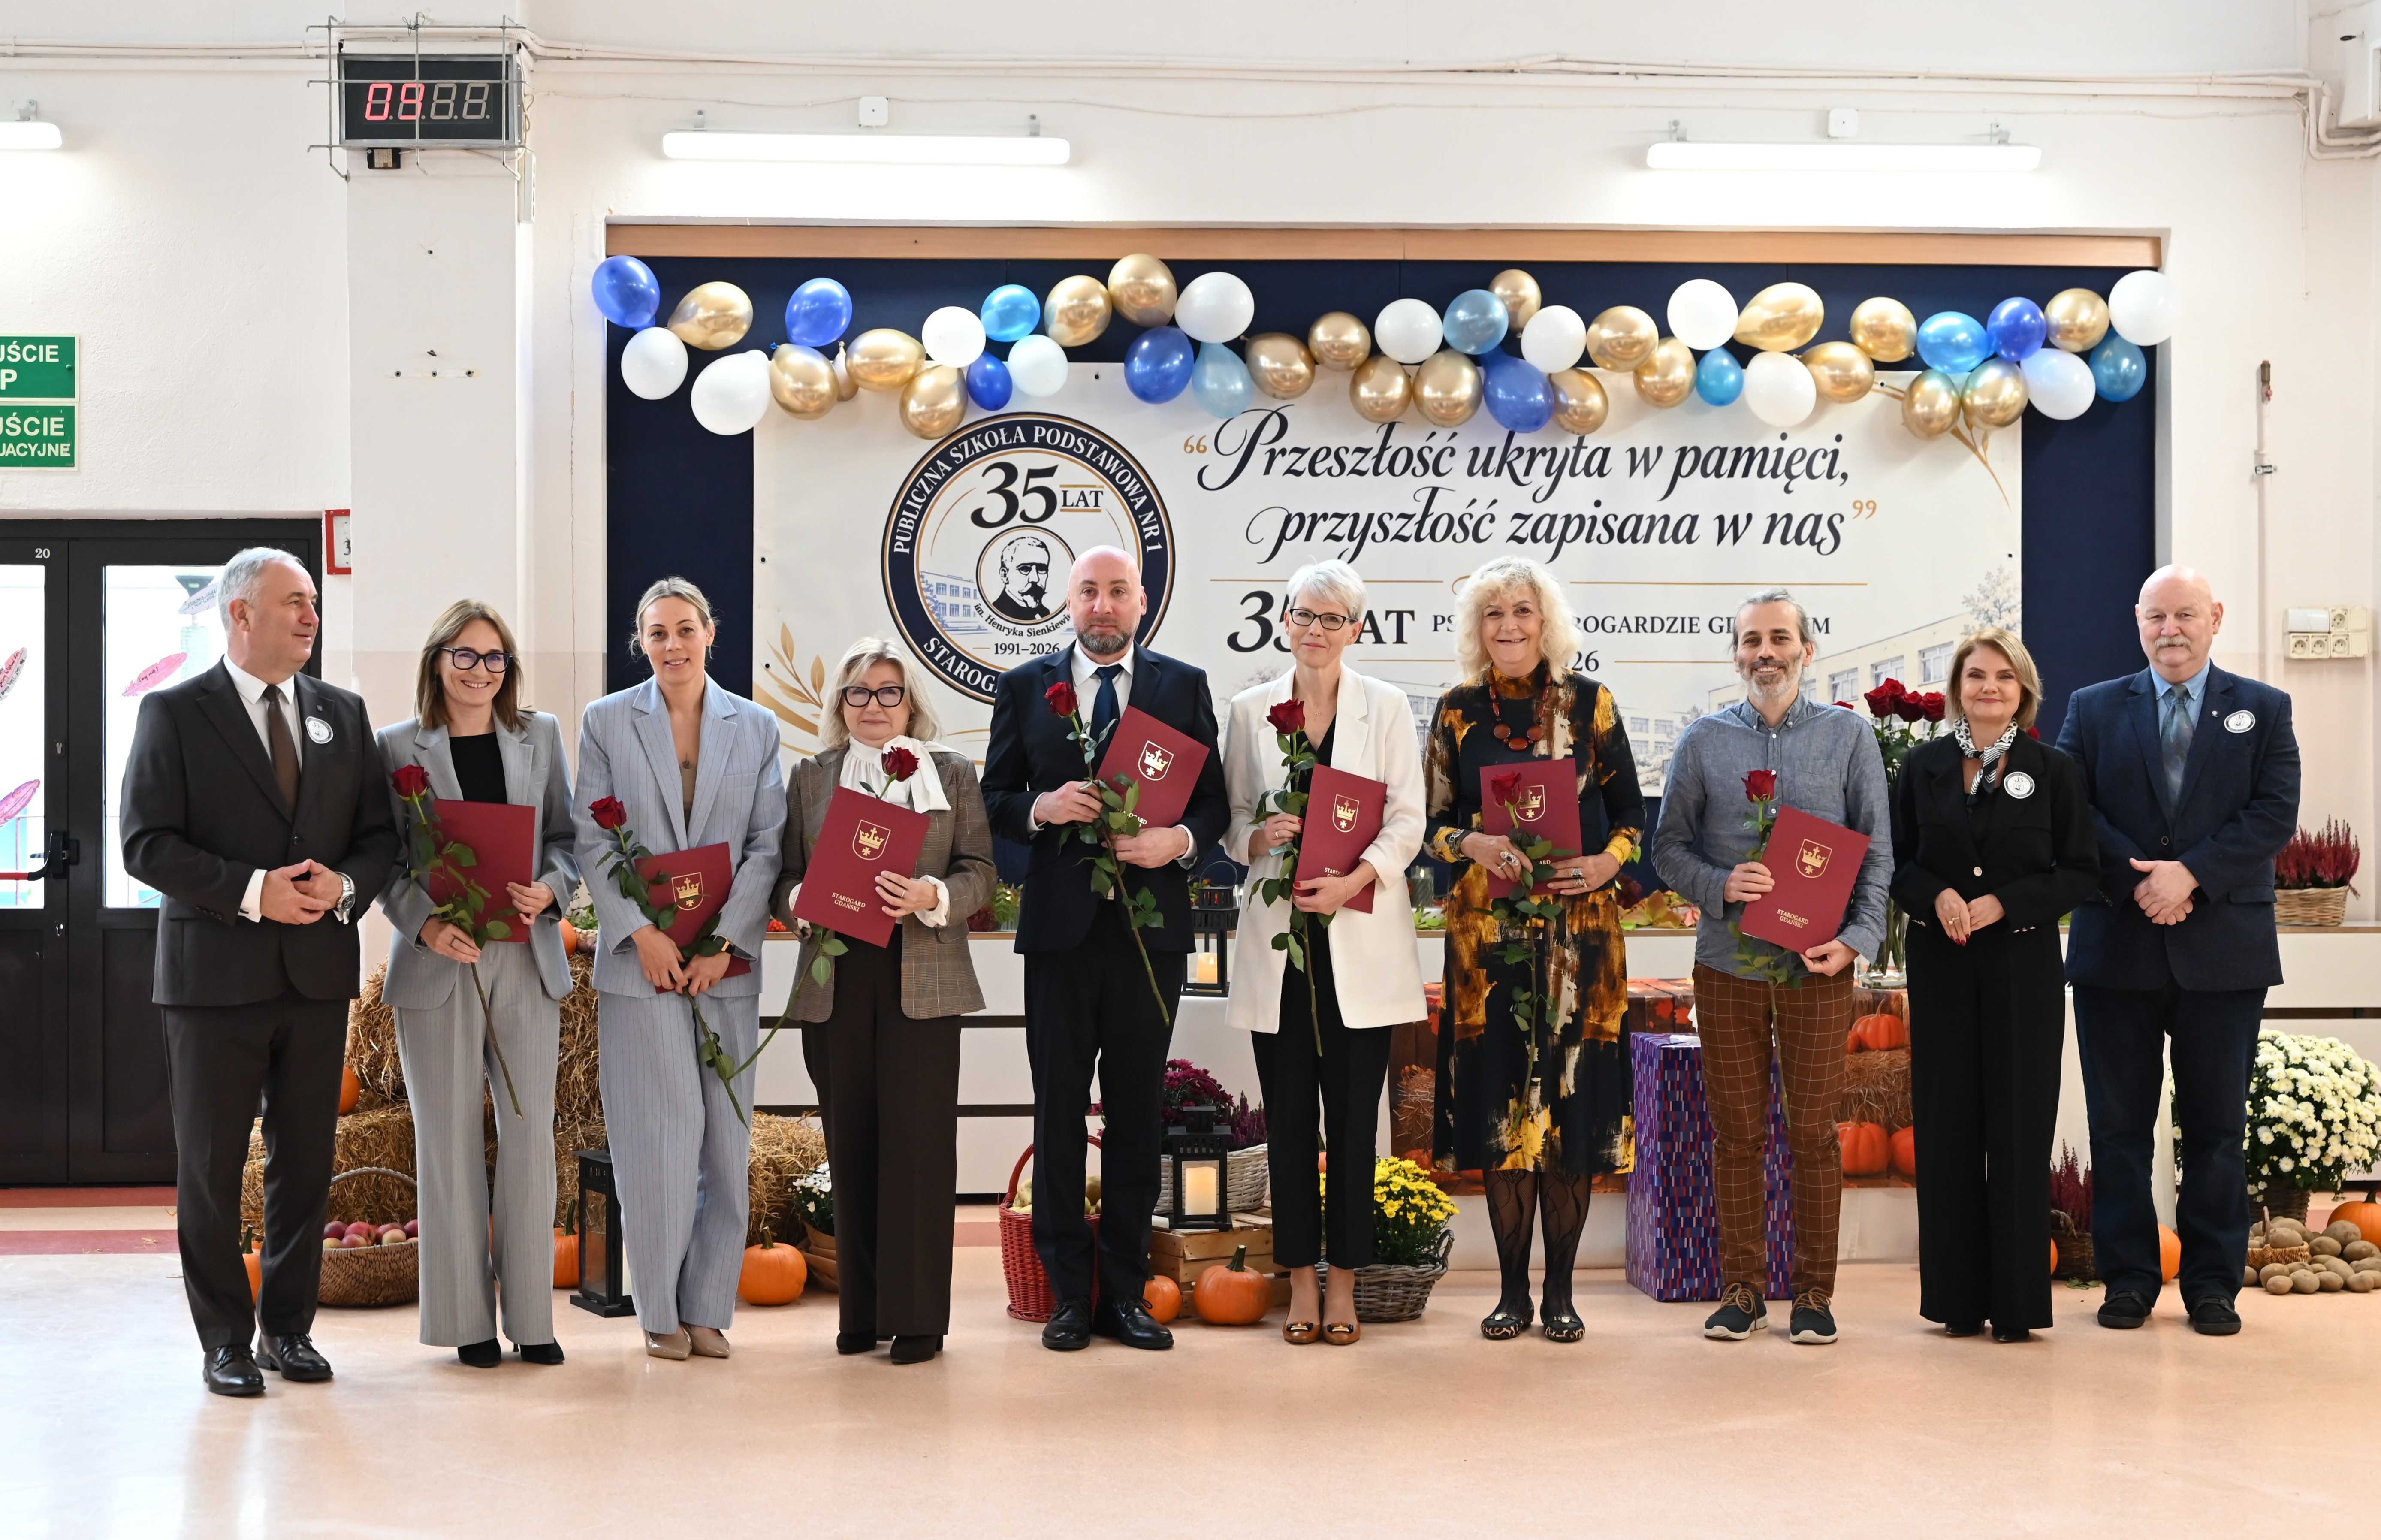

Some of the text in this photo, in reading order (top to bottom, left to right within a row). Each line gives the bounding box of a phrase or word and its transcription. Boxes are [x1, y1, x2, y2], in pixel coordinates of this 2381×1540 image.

[0, 369, 18, 390] P
[1467, 430, 1613, 504] ukryta
[1625, 444, 1664, 478] w
[1657, 432, 1849, 502] pamięci,
[893, 426, 1163, 554] PUBLICZNA SZKOŁA PODSTAWOWA NR 1
[970, 461, 1104, 528] 35 LAT
[1246, 486, 1498, 565] przyszłość
[1506, 499, 1700, 564] zapisana
[1713, 513, 1753, 547] w
[35, 548, 51, 559] 20
[974, 603, 983, 618] im.
[985, 614, 1023, 637] Henryka
[1354, 610, 1415, 644] AT
[1576, 616, 1701, 634] OGARDZIE
[923, 637, 997, 694] STAROG
[1571, 650, 1599, 672] 26
[832, 892, 866, 908] STAROGARD
[834, 899, 860, 912] GDAŃSKI
[1777, 909, 1809, 924] STAROGARD
[1779, 915, 1804, 929] GDAŃSKI
